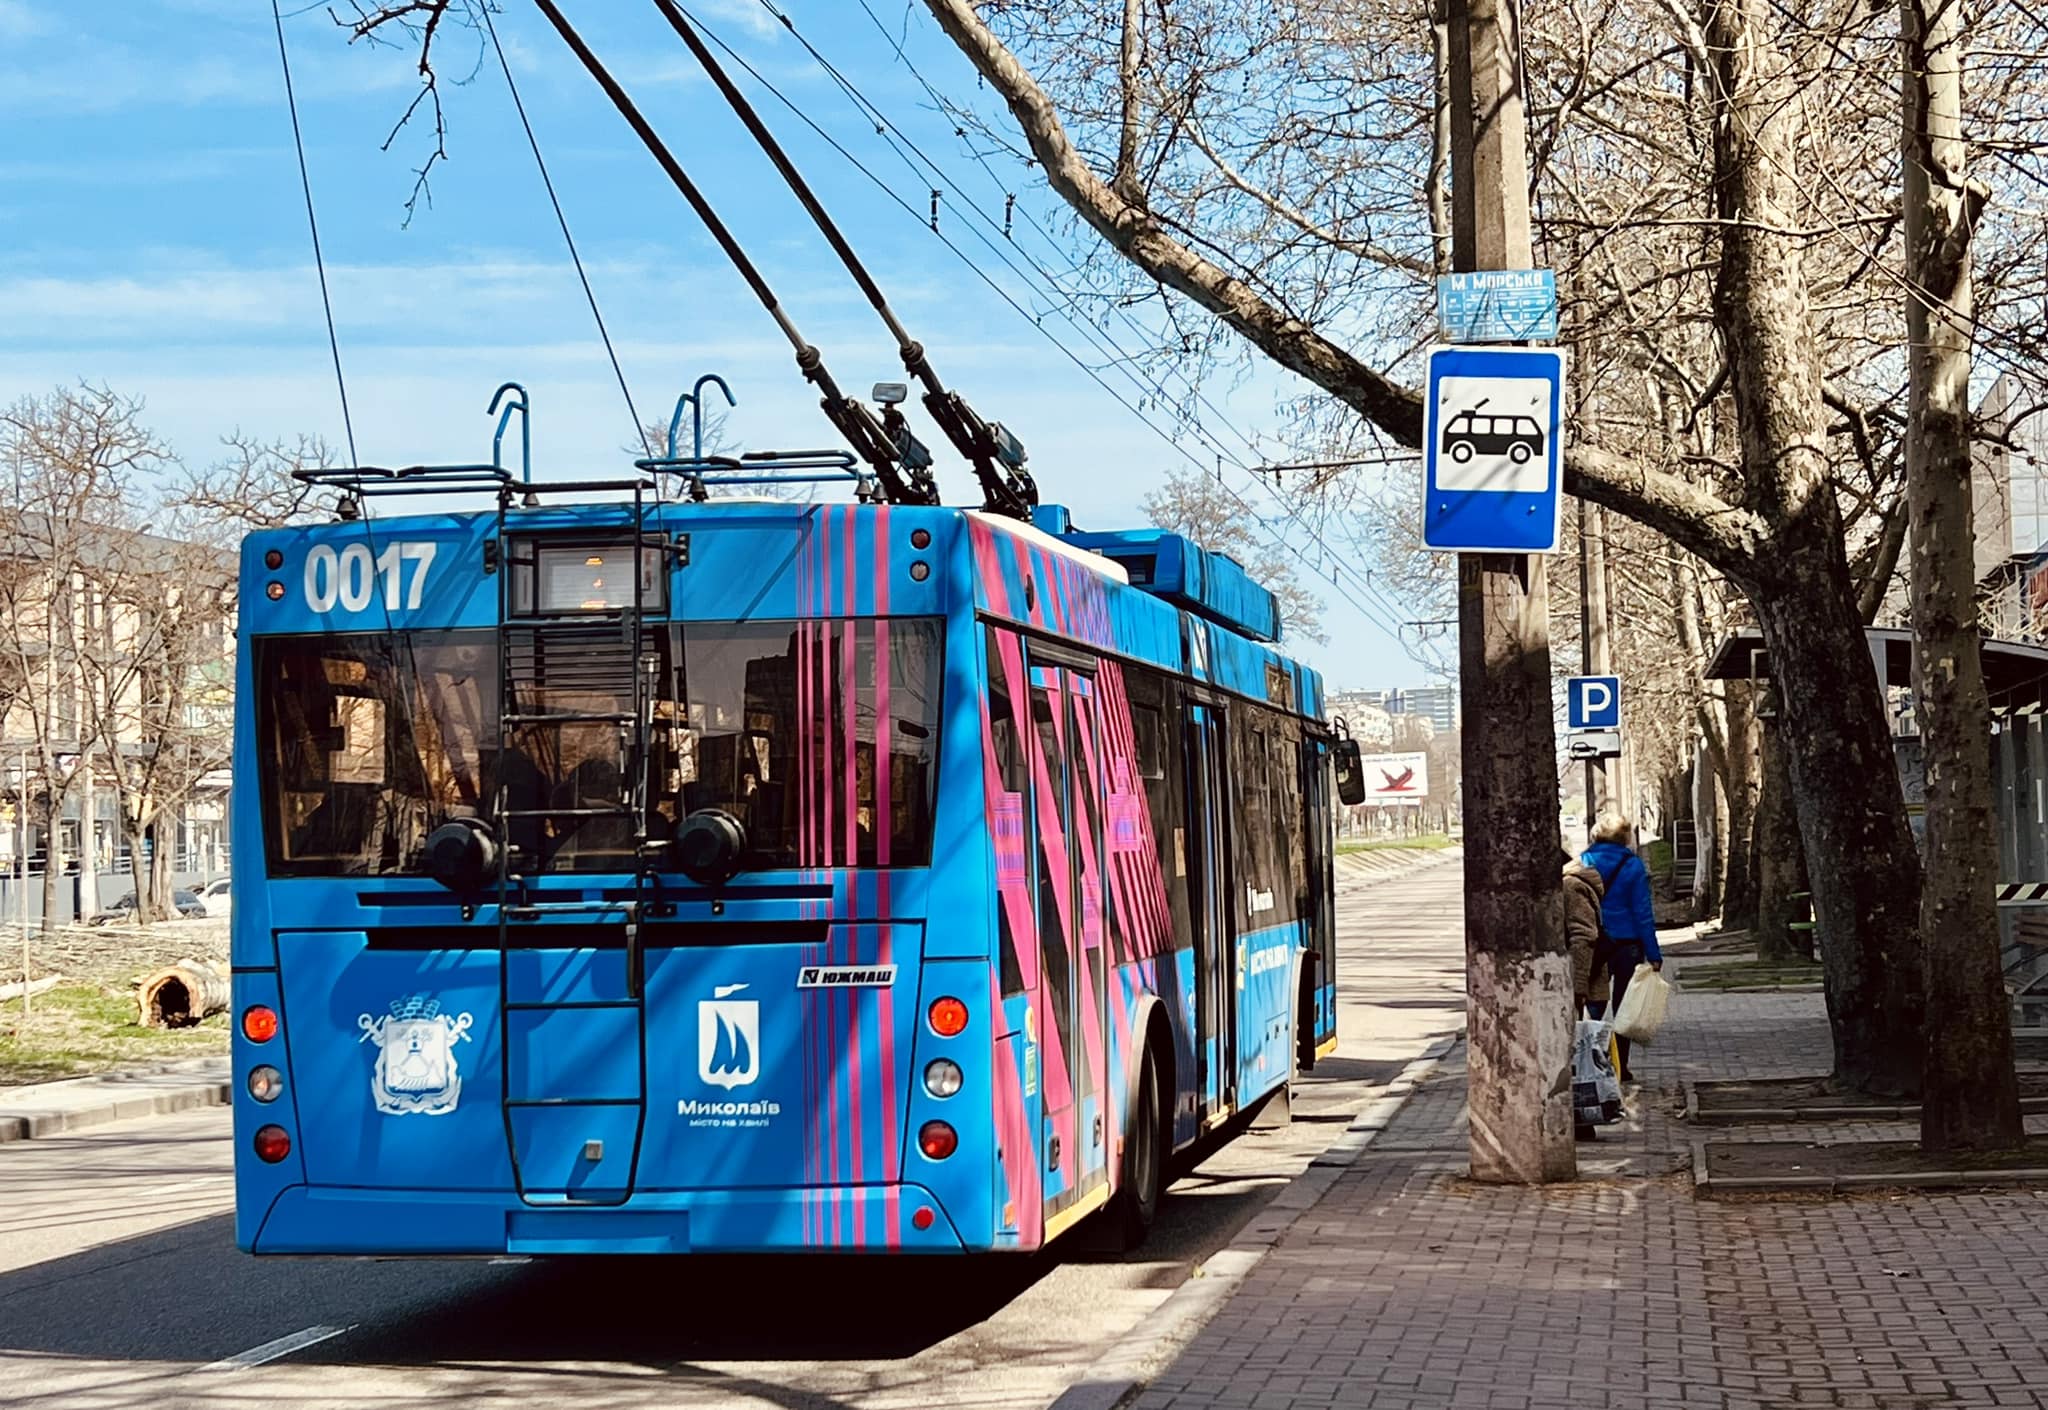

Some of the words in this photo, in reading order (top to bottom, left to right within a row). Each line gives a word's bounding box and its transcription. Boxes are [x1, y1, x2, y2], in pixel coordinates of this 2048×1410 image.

[304, 541, 437, 613] 0017
[1582, 682, 1611, 723] P
[822, 970, 892, 984] ЮЖМАШ
[677, 1099, 780, 1115] Миколаїв
